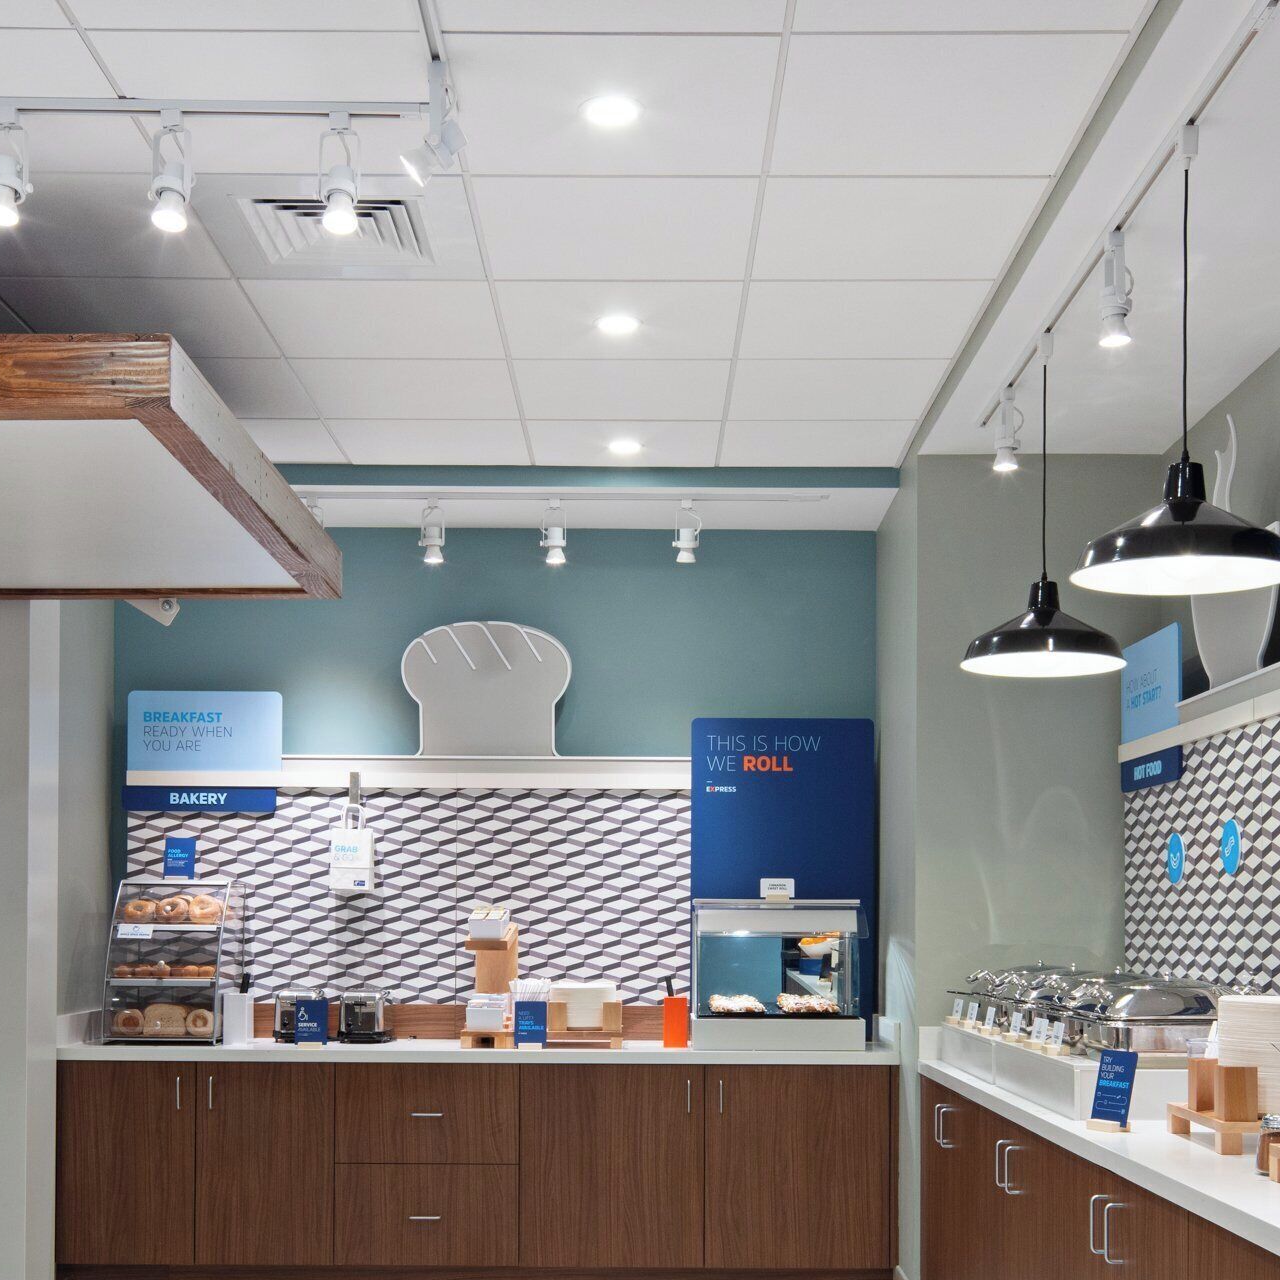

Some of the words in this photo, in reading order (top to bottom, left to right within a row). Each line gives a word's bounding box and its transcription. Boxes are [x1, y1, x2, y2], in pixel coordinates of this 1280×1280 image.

[143, 711, 223, 723] BREAKFAST
[143, 725, 189, 738] READY
[192, 725, 233, 738] WHEN
[143, 739, 171, 751] YOU
[175, 739, 202, 751] ARE
[707, 735, 746, 752] THIS
[753, 735, 768, 752] IS
[775, 735, 821, 752] HOW
[706, 755, 737, 772] WE
[742, 755, 794, 772] ROLL
[1133, 764, 1146, 781] HOT
[1146, 760, 1162, 777] FOOD
[169, 792, 228, 805] BAKERY
[334, 845, 358, 853] GRAB
[1103, 1055, 1113, 1063] TRY
[1101, 1063, 1125, 1073] BUILDING
[1100, 1071, 1115, 1080] YOUR
[1098, 1079, 1130, 1089] BREAKFAST
